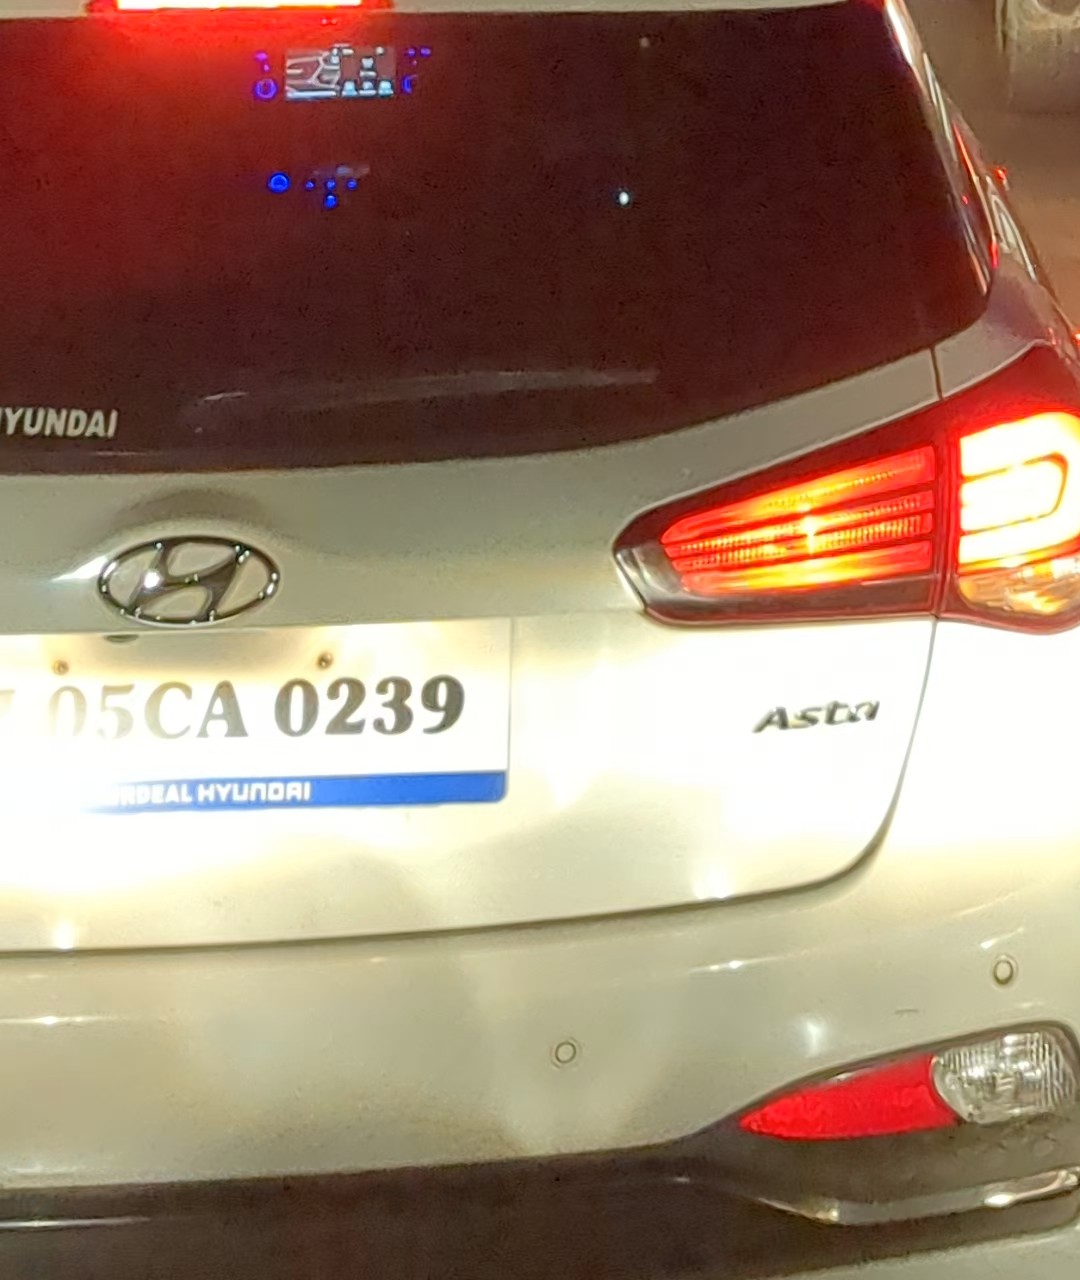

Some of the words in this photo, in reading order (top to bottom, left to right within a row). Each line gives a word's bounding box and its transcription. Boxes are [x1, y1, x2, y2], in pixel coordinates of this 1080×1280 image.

[0, 406, 119, 439] YUNDAI
[48, 680, 248, 739] 05CA
[274, 674, 465, 737] 0239
[752, 700, 880, 734] Asta
[198, 781, 312, 804] HYUNDAI
